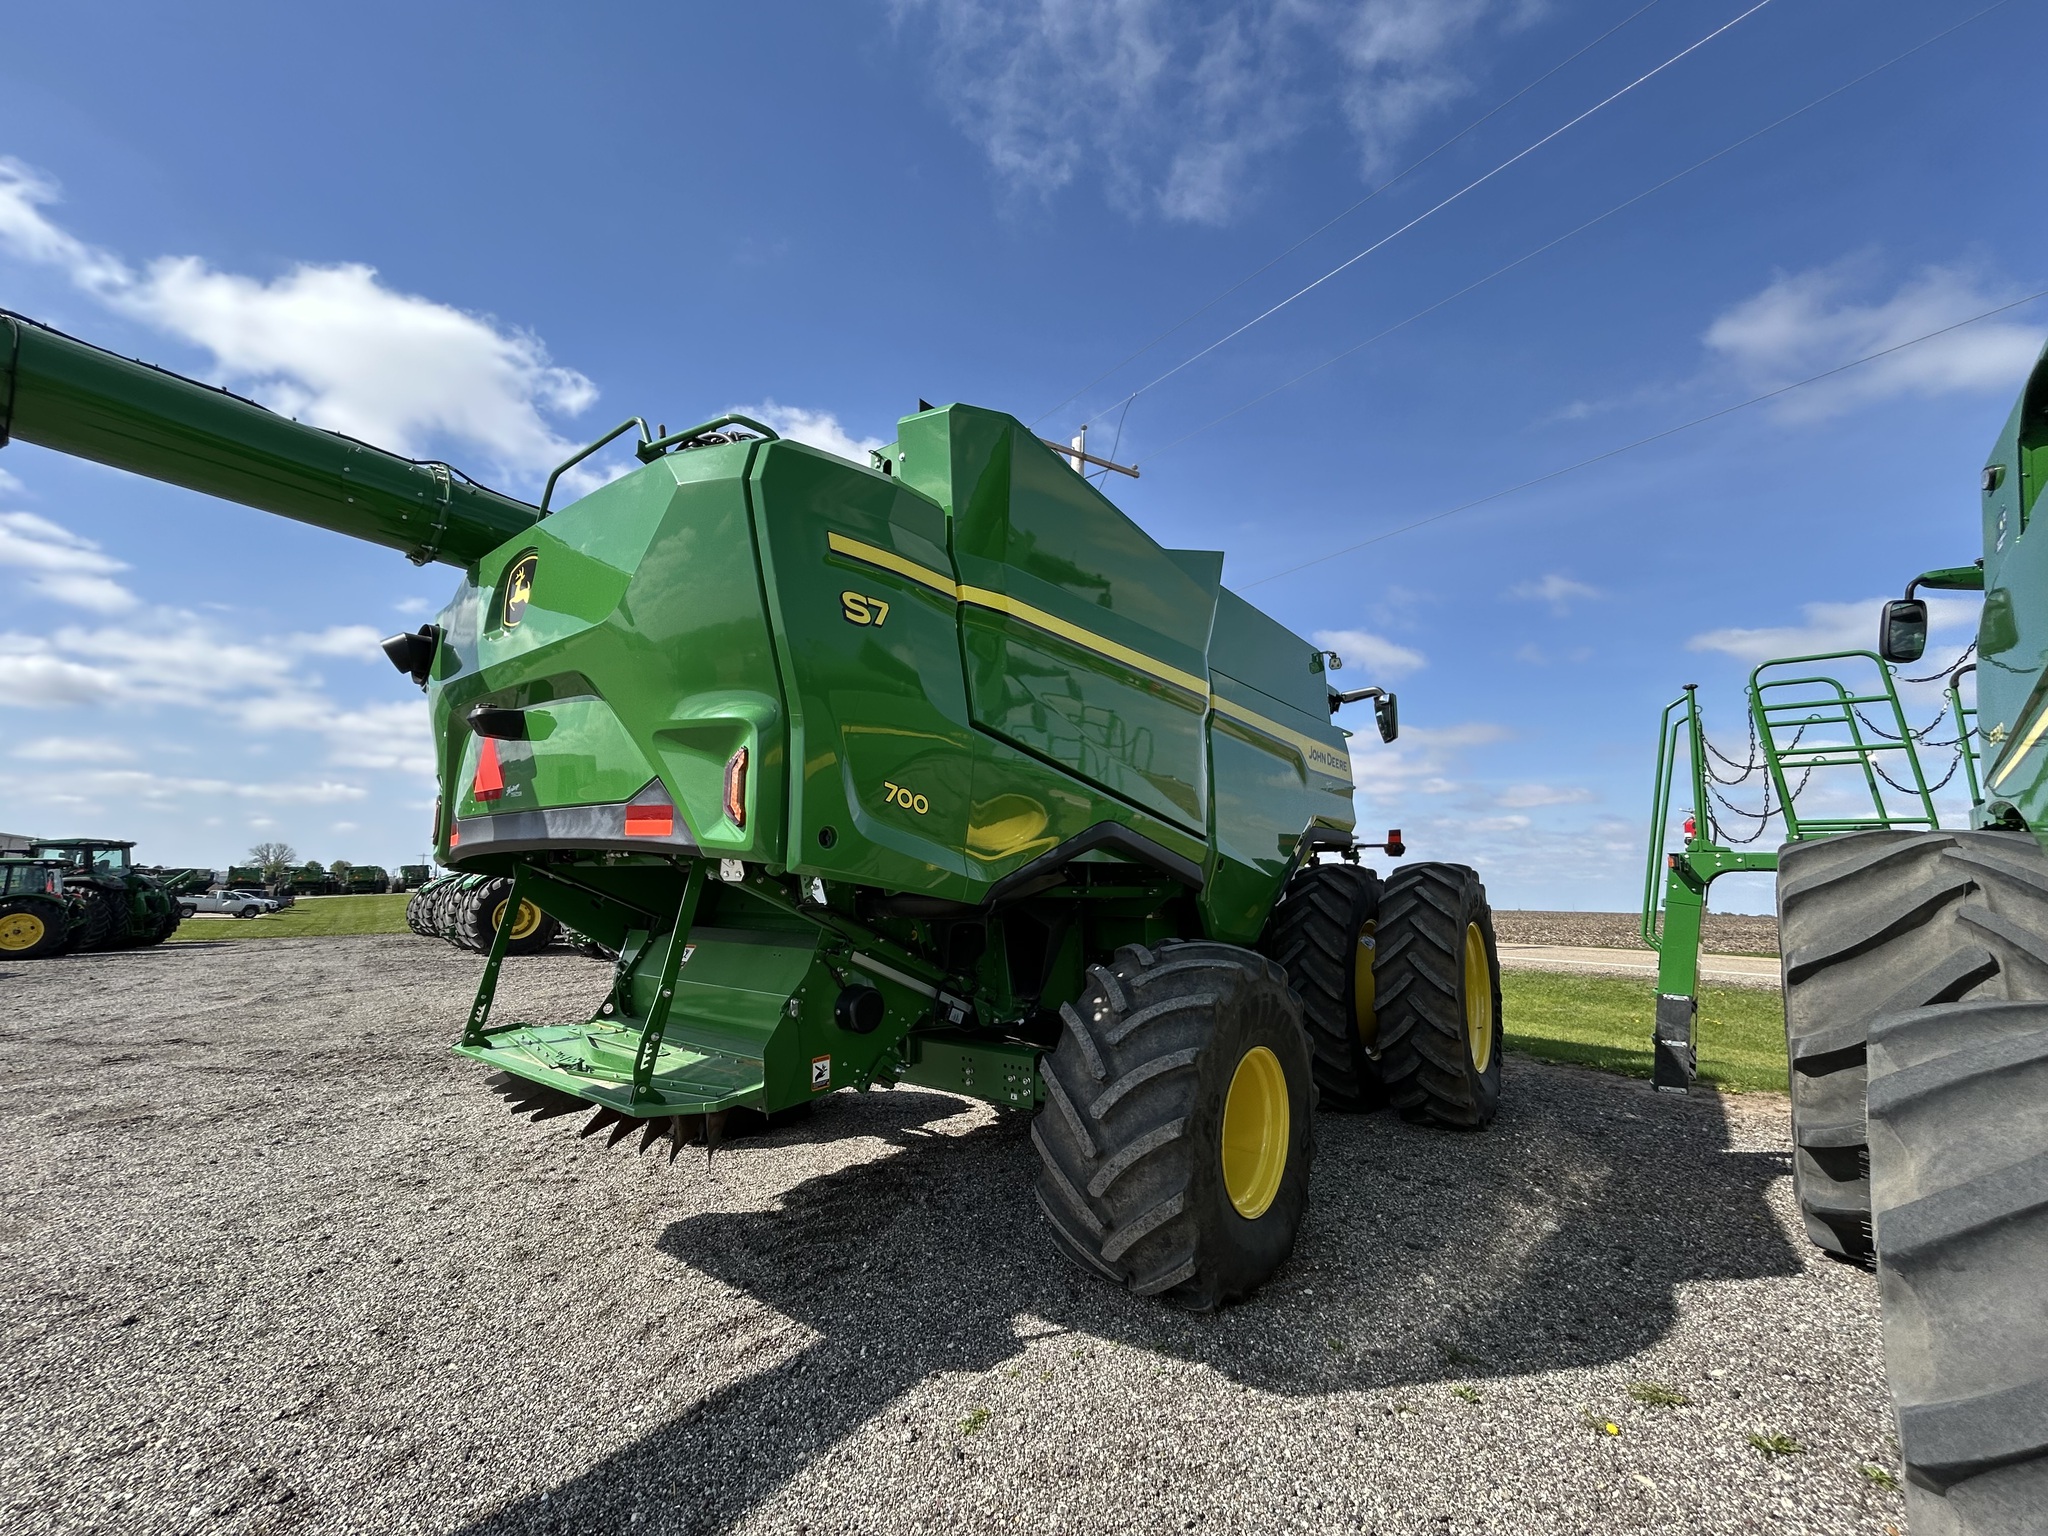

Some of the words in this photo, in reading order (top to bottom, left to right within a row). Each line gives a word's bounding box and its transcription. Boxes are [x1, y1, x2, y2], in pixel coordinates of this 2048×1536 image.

[840, 590, 890, 627] S7
[1309, 746, 1326, 764] JOHN
[1327, 753, 1347, 771] DEERE
[883, 780, 930, 815] 700
